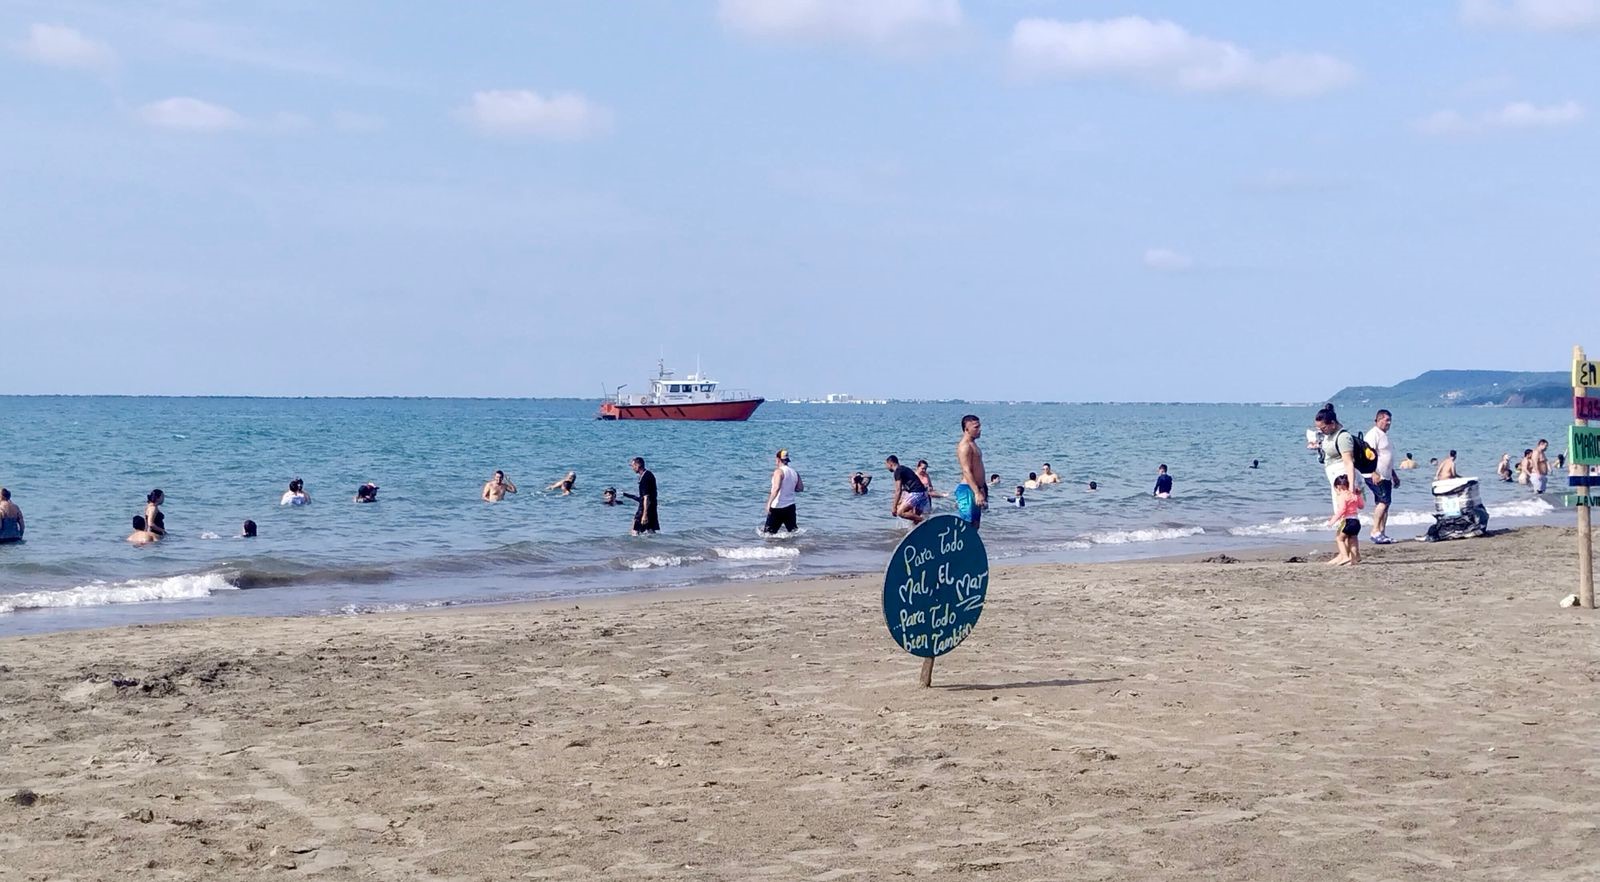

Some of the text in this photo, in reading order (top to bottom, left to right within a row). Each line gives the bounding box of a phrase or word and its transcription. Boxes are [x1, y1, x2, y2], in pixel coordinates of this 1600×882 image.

[904, 545, 935, 576] Para
[956, 571, 988, 602] Mar
[929, 603, 957, 630] Todo
[902, 633, 928, 653] bien
